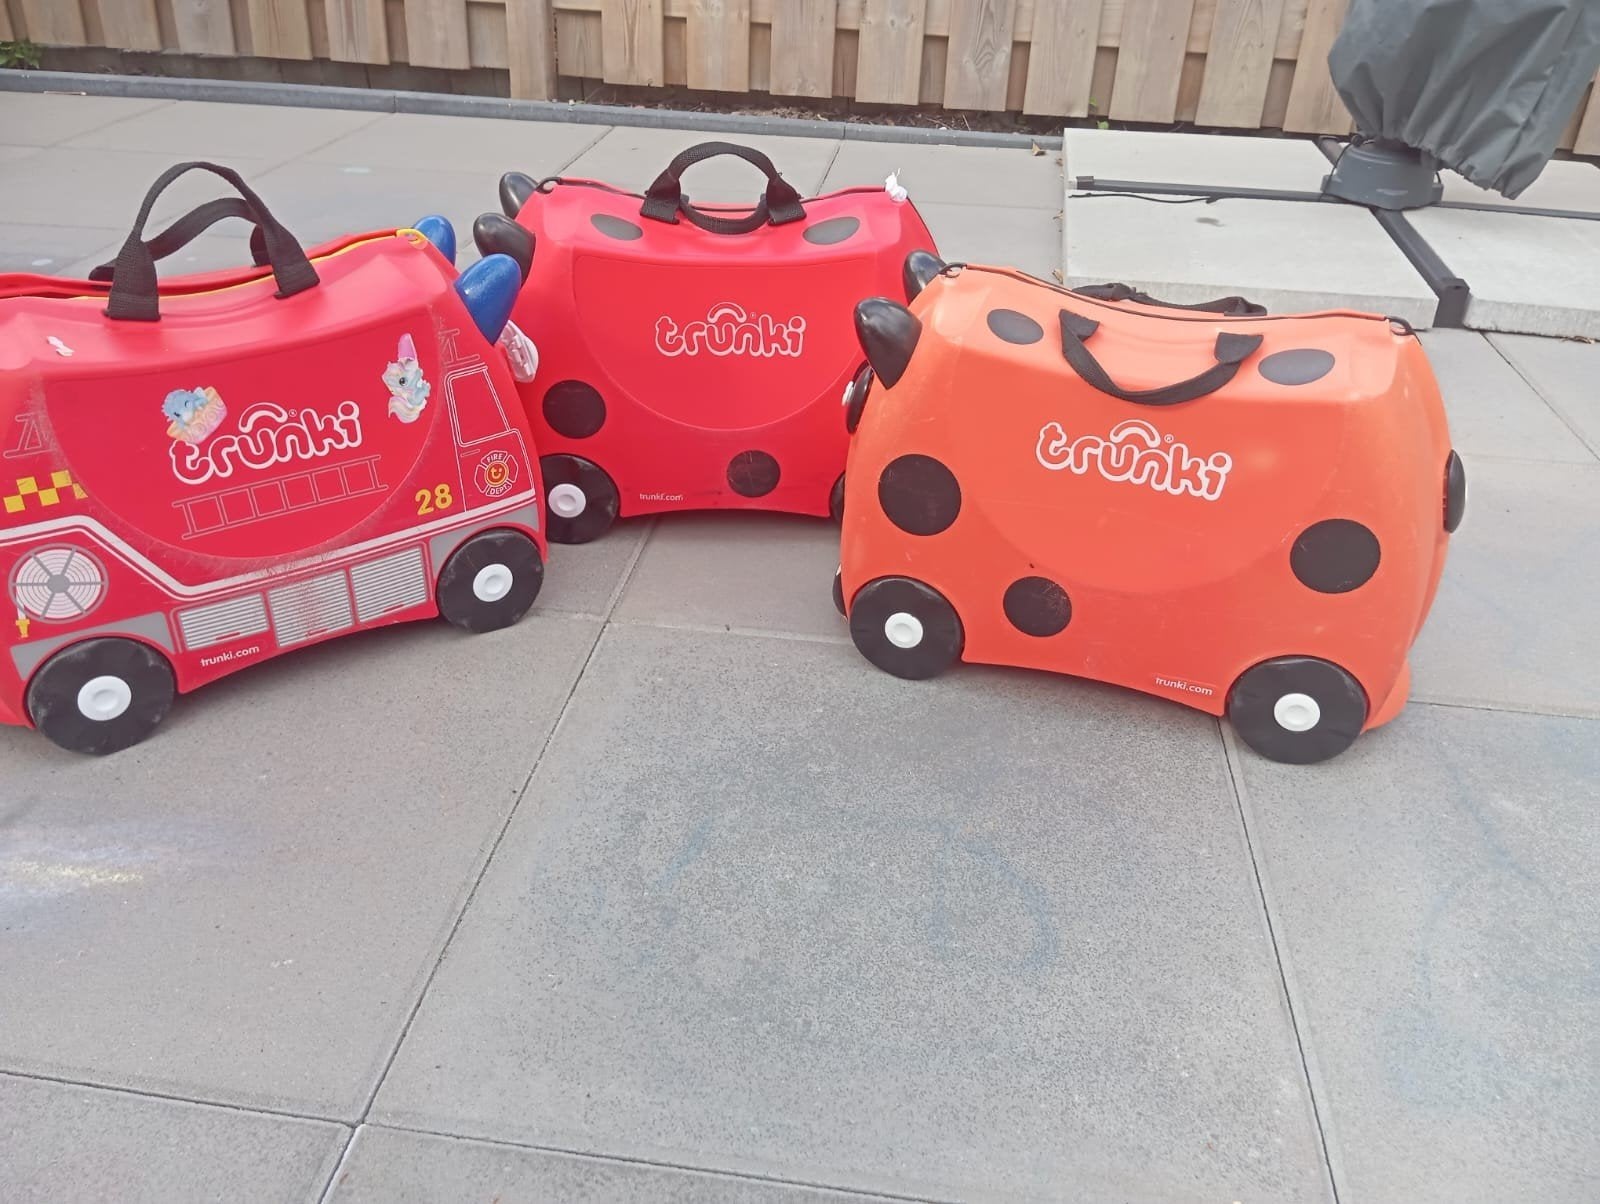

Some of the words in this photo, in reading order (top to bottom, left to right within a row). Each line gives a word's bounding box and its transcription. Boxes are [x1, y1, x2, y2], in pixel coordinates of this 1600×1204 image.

[654, 301, 807, 358] trunki
[168, 401, 364, 485] trunki
[486, 453, 503, 463] FIRE
[1035, 419, 1233, 501] trunki
[415, 483, 453, 516] 28
[639, 493, 684, 501] trunki.com
[200, 645, 260, 667] trunki.com
[1155, 677, 1213, 696] trunki.com
